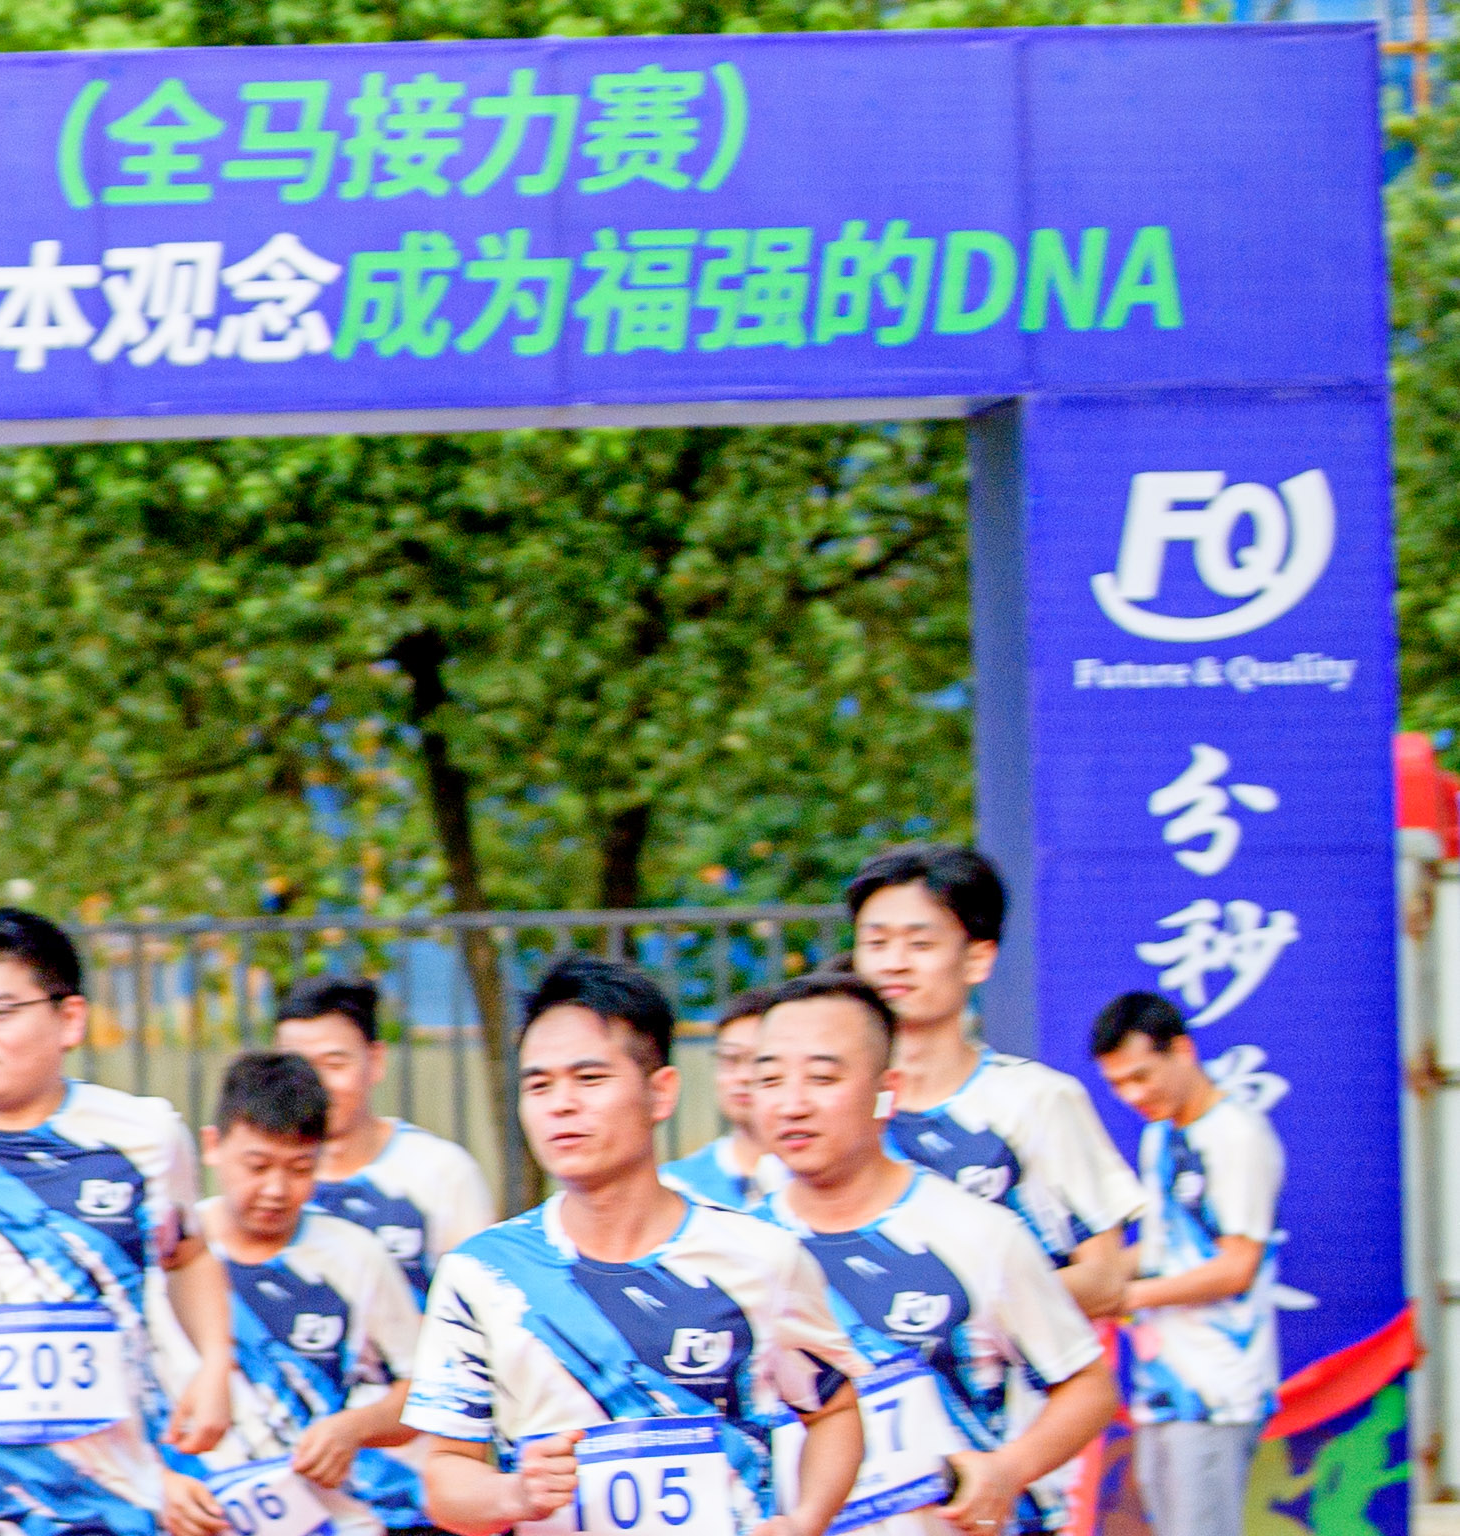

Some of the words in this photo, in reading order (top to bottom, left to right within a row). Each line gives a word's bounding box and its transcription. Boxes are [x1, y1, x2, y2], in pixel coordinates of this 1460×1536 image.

[1072, 658, 1191, 689] Future
[1192, 656, 1225, 687] &
[1225, 653, 1357, 692] Quality
